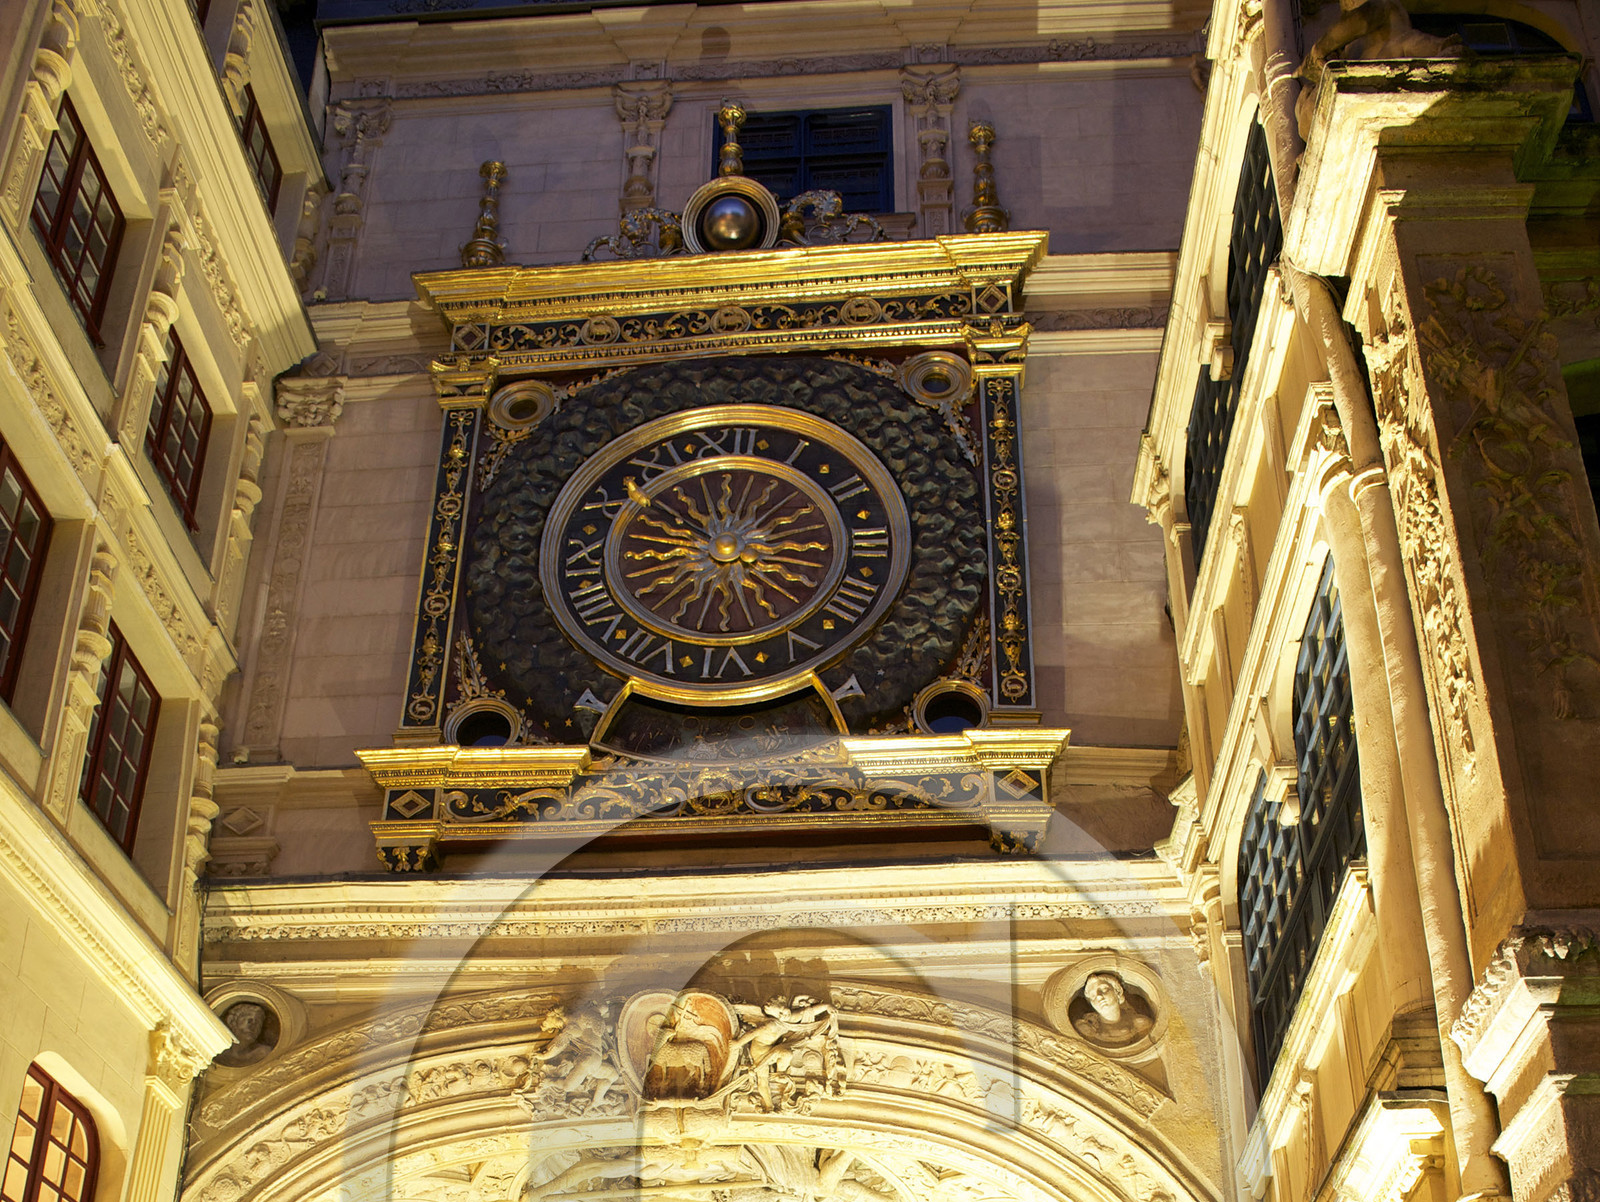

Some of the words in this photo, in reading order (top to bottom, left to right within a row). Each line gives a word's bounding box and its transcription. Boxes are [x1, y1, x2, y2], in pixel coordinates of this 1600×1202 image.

[693, 428, 760, 459] XII
[827, 473, 870, 502] II
[851, 525, 888, 558] III
